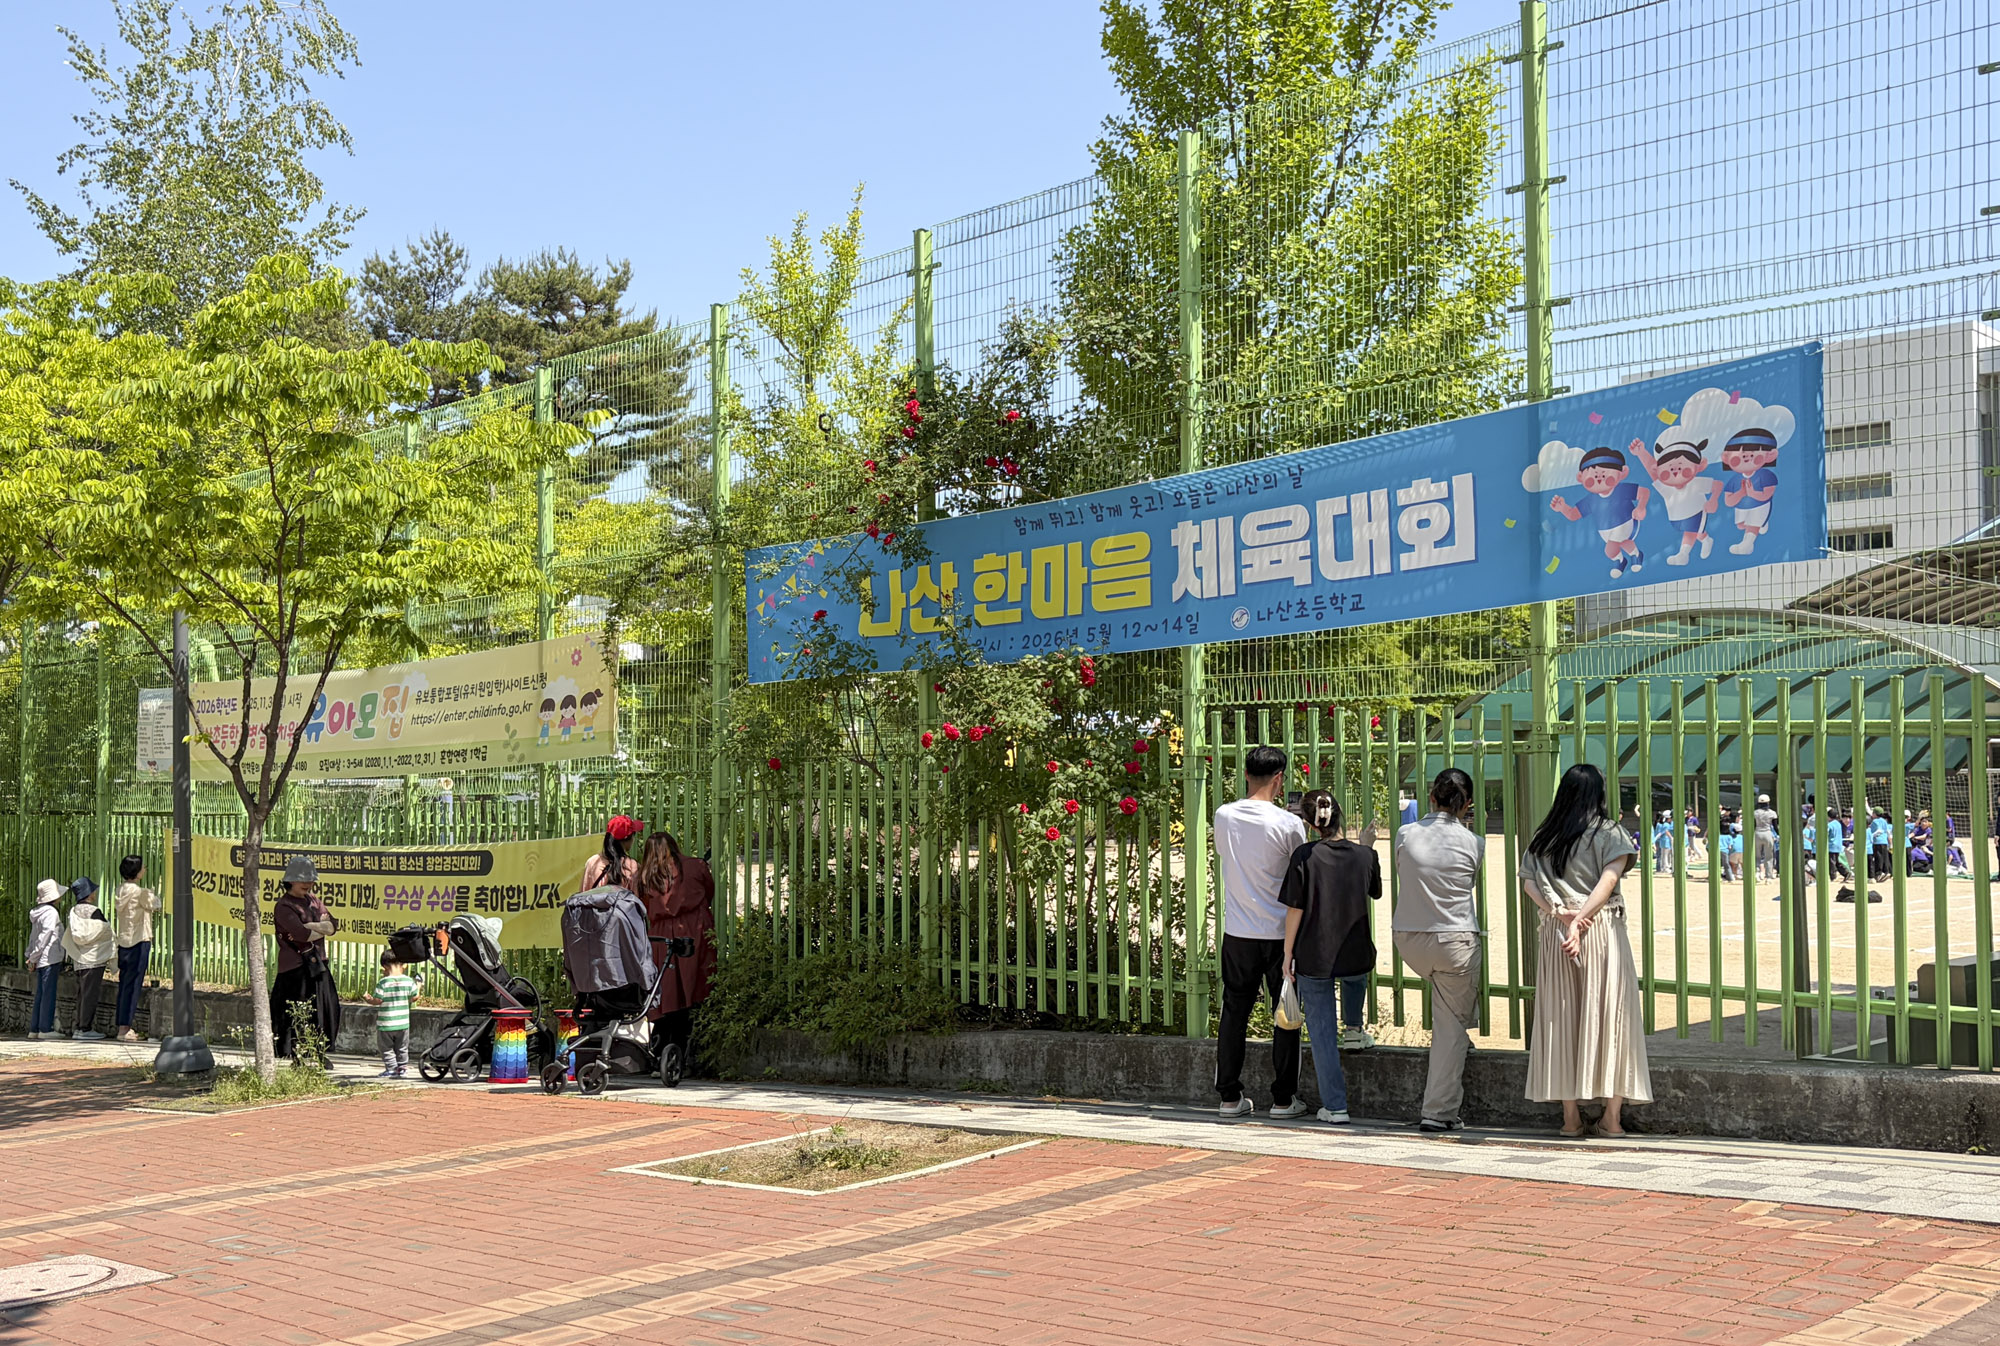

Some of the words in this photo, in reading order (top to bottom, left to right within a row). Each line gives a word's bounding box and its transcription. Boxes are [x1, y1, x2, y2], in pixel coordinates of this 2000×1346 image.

[1013, 515, 1044, 536] 함께
[1049, 507, 1084, 530] 뛰고!
[1089, 502, 1122, 523] 함께
[1129, 492, 1164, 519] 웃고!
[1173, 481, 1218, 509] 오늘은
[1226, 473, 1278, 496] 나산의
[1288, 464, 1305, 489] 날
[858, 561, 958, 638] 나산
[973, 531, 1151, 627] 한마음
[1171, 472, 1476, 603] 체육대회
[1257, 592, 1366, 622] 나산초등학교
[1021, 626, 1079, 650] 2026년
[1086, 623, 1112, 645] 5월
[1121, 611, 1200, 640] 12~14일
[196, 696, 237, 716] 2026학년도
[304, 683, 411, 744] 유아모집
[410, 700, 534, 727] https://enter.childinfo.go.kr
[363, 854, 379, 871] 국내
[381, 855, 397, 872] 최대
[399, 855, 424, 872] 청소년
[426, 854, 481, 873] 창업경진대회!
[383, 884, 424, 912] 우수상
[426, 884, 470, 912] 수상을
[474, 883, 561, 912] 축하합니다!
